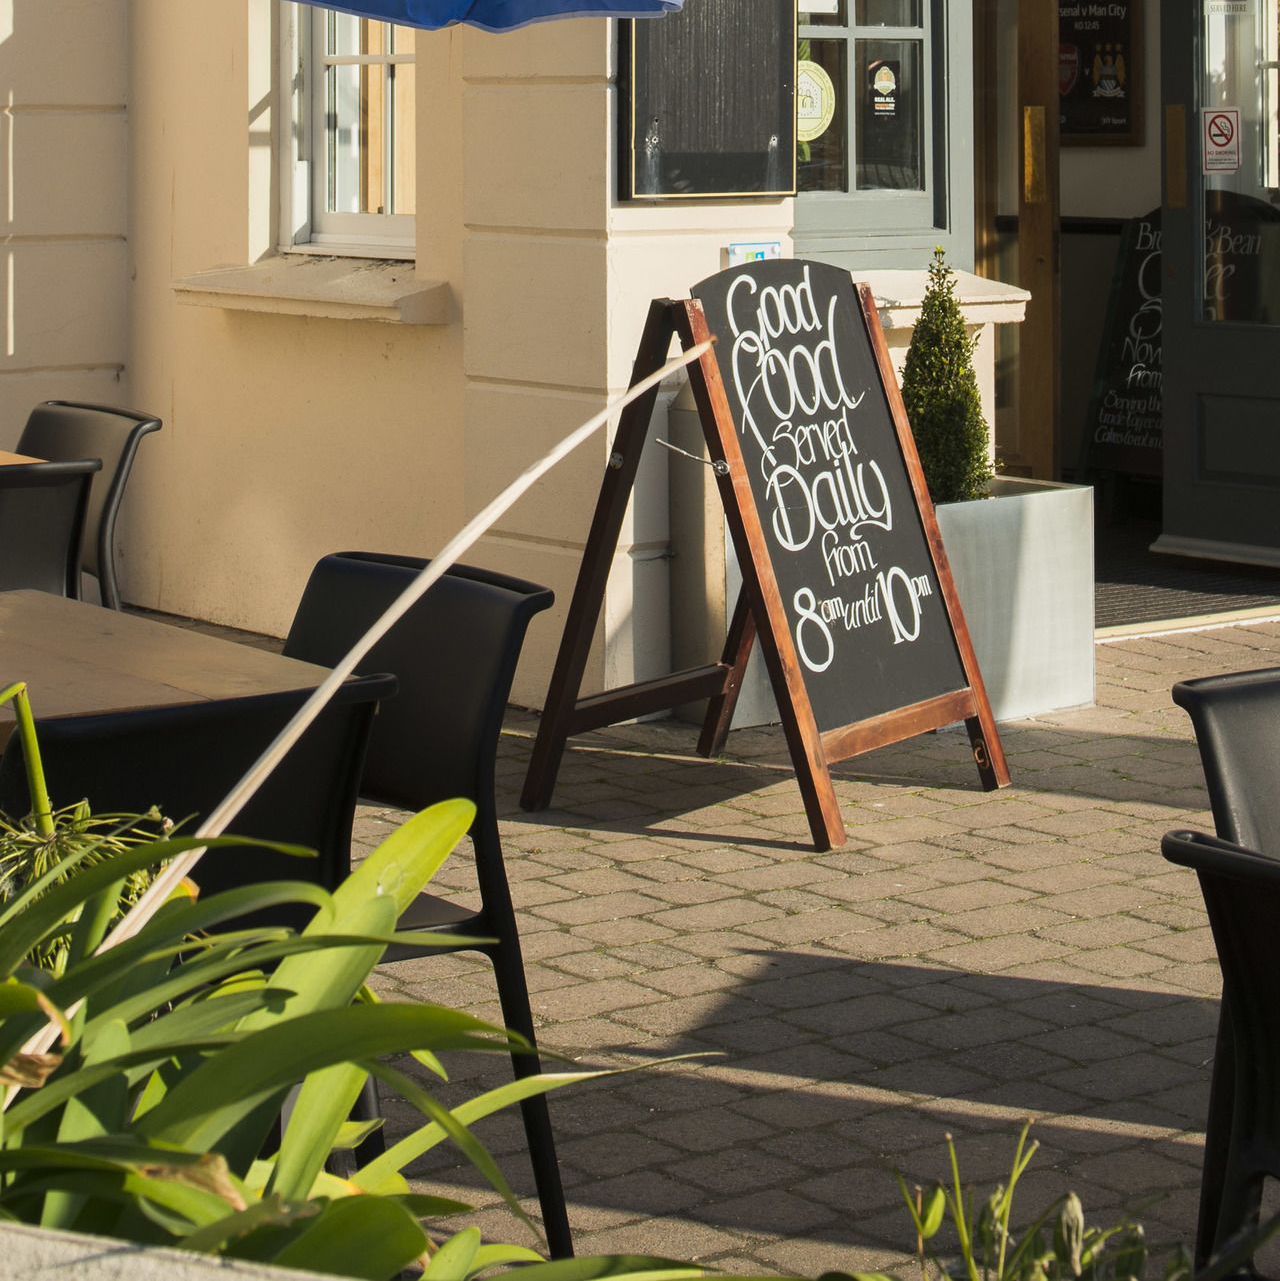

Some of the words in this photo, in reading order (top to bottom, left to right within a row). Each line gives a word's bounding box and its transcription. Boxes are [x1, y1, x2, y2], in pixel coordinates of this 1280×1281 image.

[1059, 4, 1081, 17] senal
[1088, 4, 1107, 17] Man
[1108, 3, 1127, 20] City
[1217, 225, 1262, 256] Bean
[726, 265, 823, 359] Good
[762, 406, 858, 486] Served
[766, 440, 893, 551] Daily
[821, 529, 878, 587] from
[844, 583, 882, 631] until
